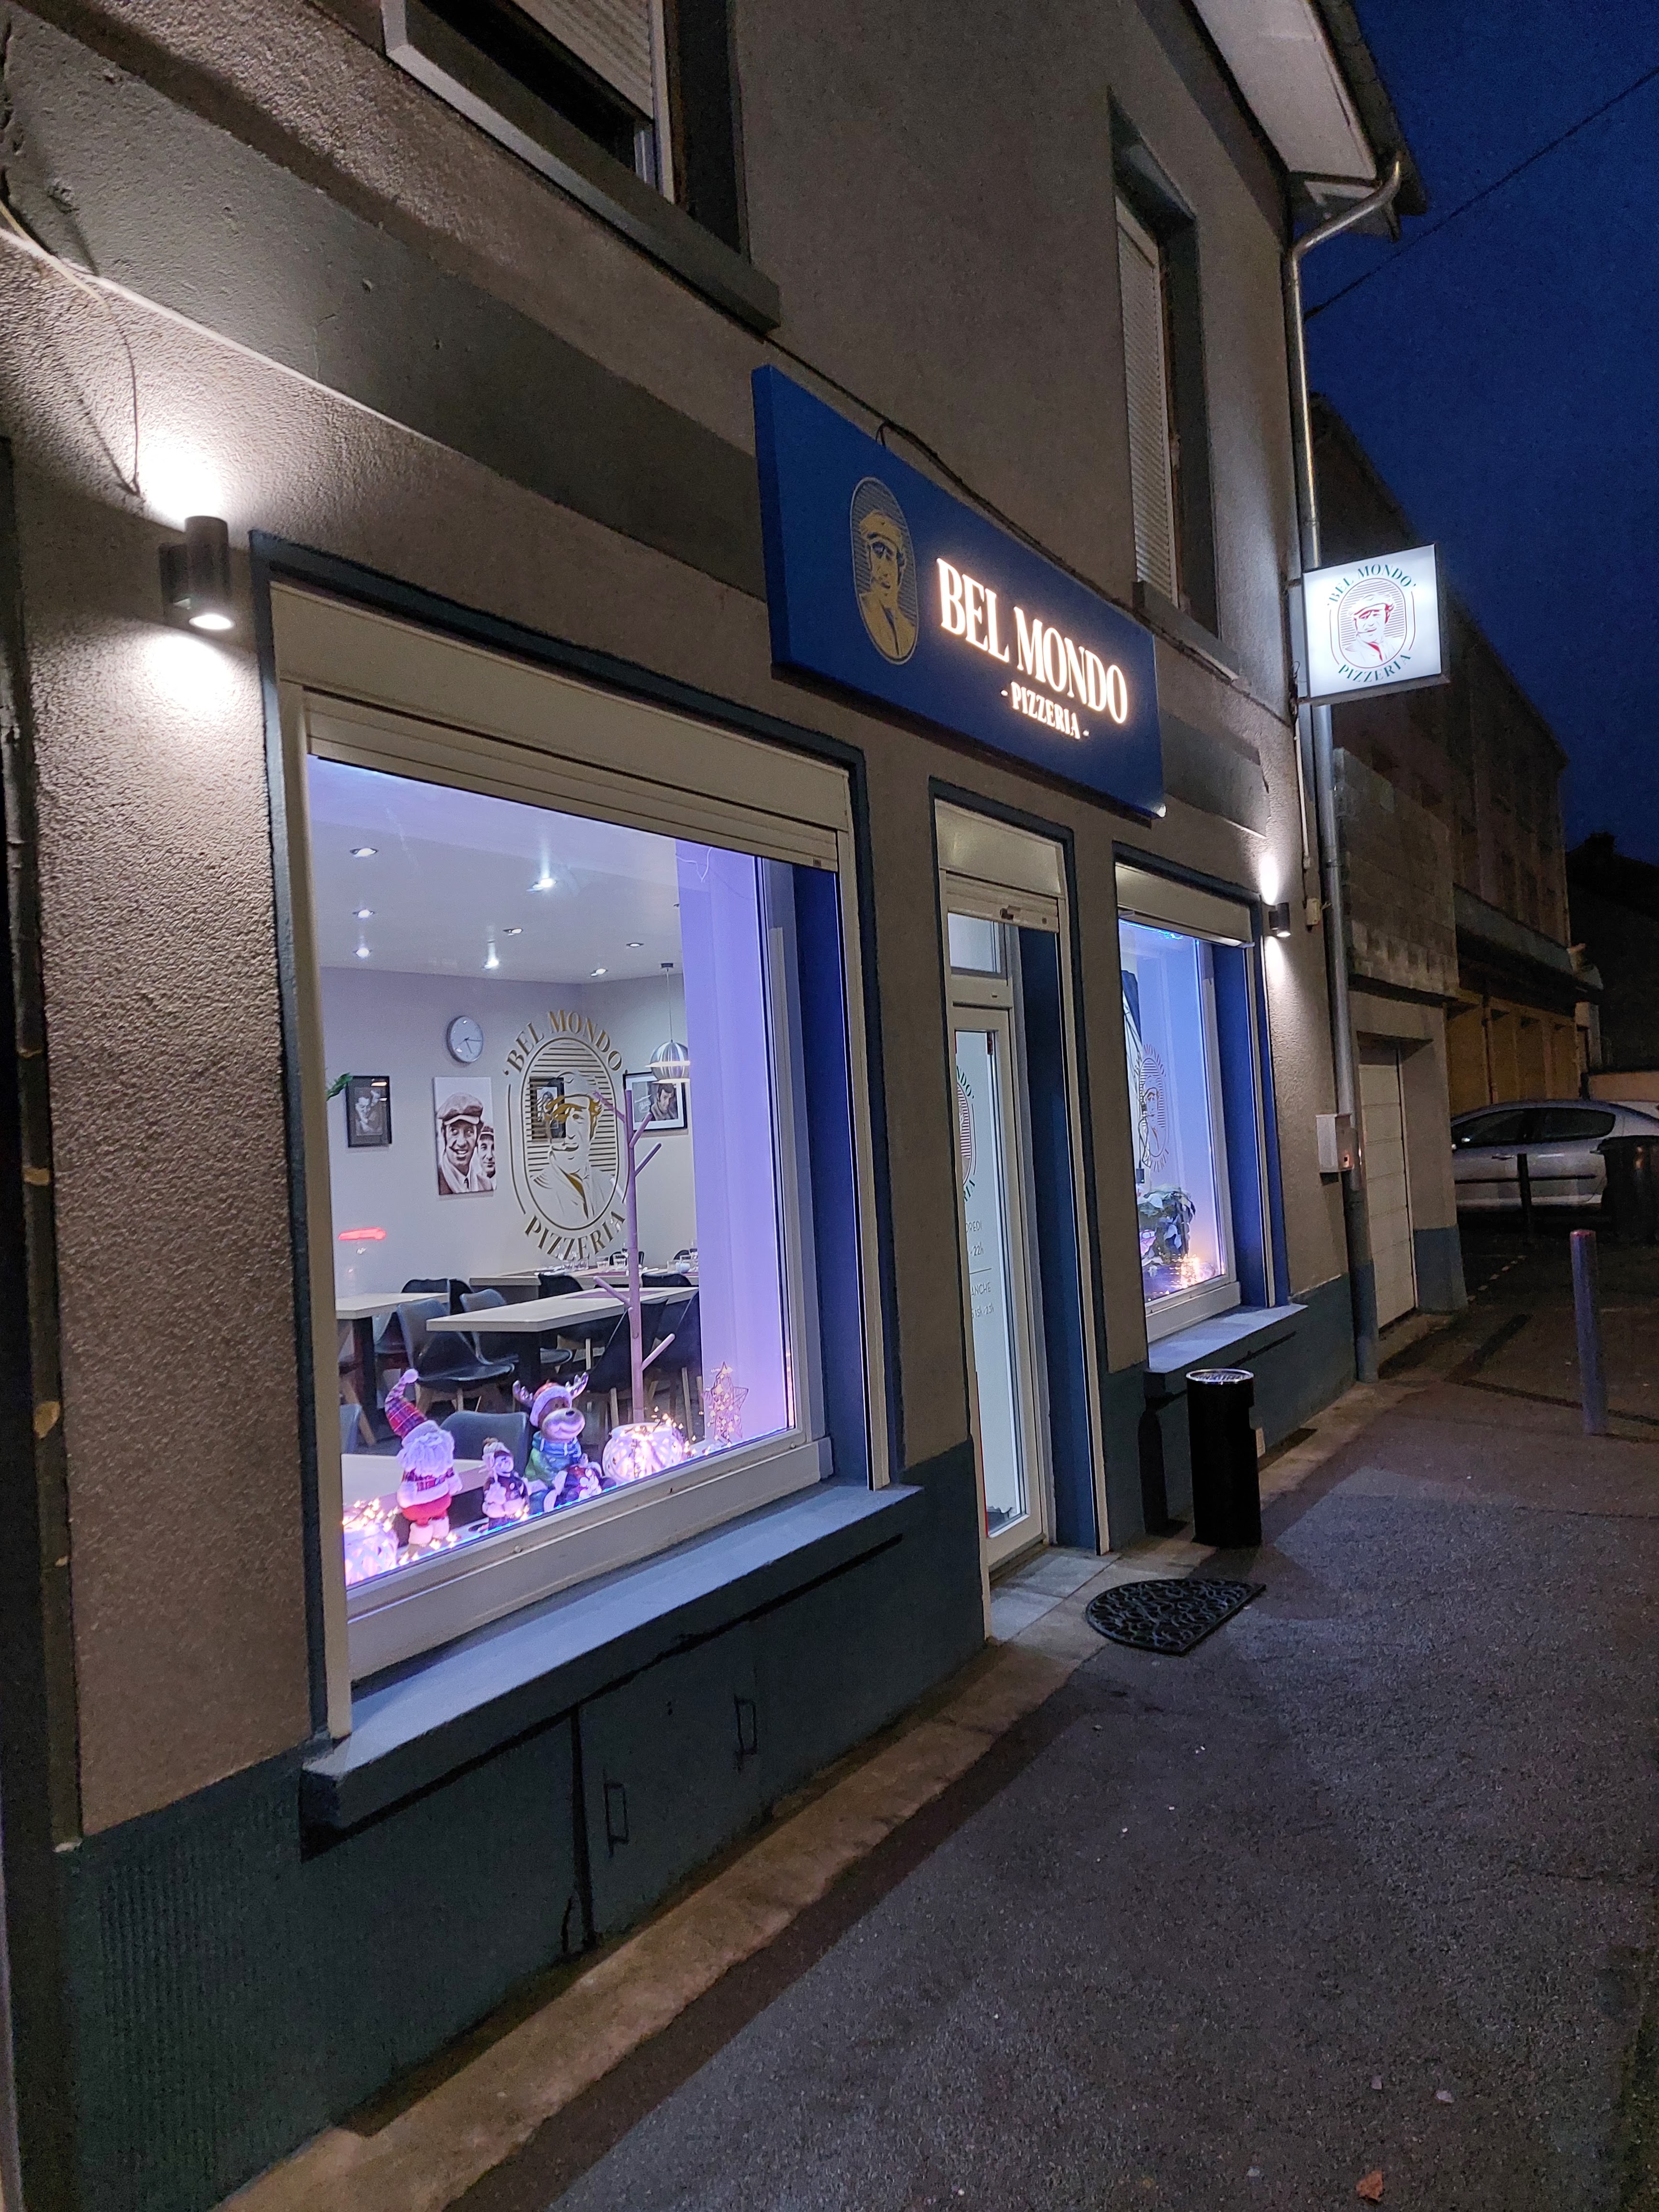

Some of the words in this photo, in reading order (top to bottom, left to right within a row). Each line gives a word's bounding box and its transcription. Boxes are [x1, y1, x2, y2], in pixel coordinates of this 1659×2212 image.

[936, 557, 1010, 664] BEL
[1013, 606, 1128, 724] MONDO
[1338, 654, 1412, 683] PIZZERIA
[1010, 681, 1081, 740] PIZZERIA
[525, 1211, 626, 1261] PIZZERIA
